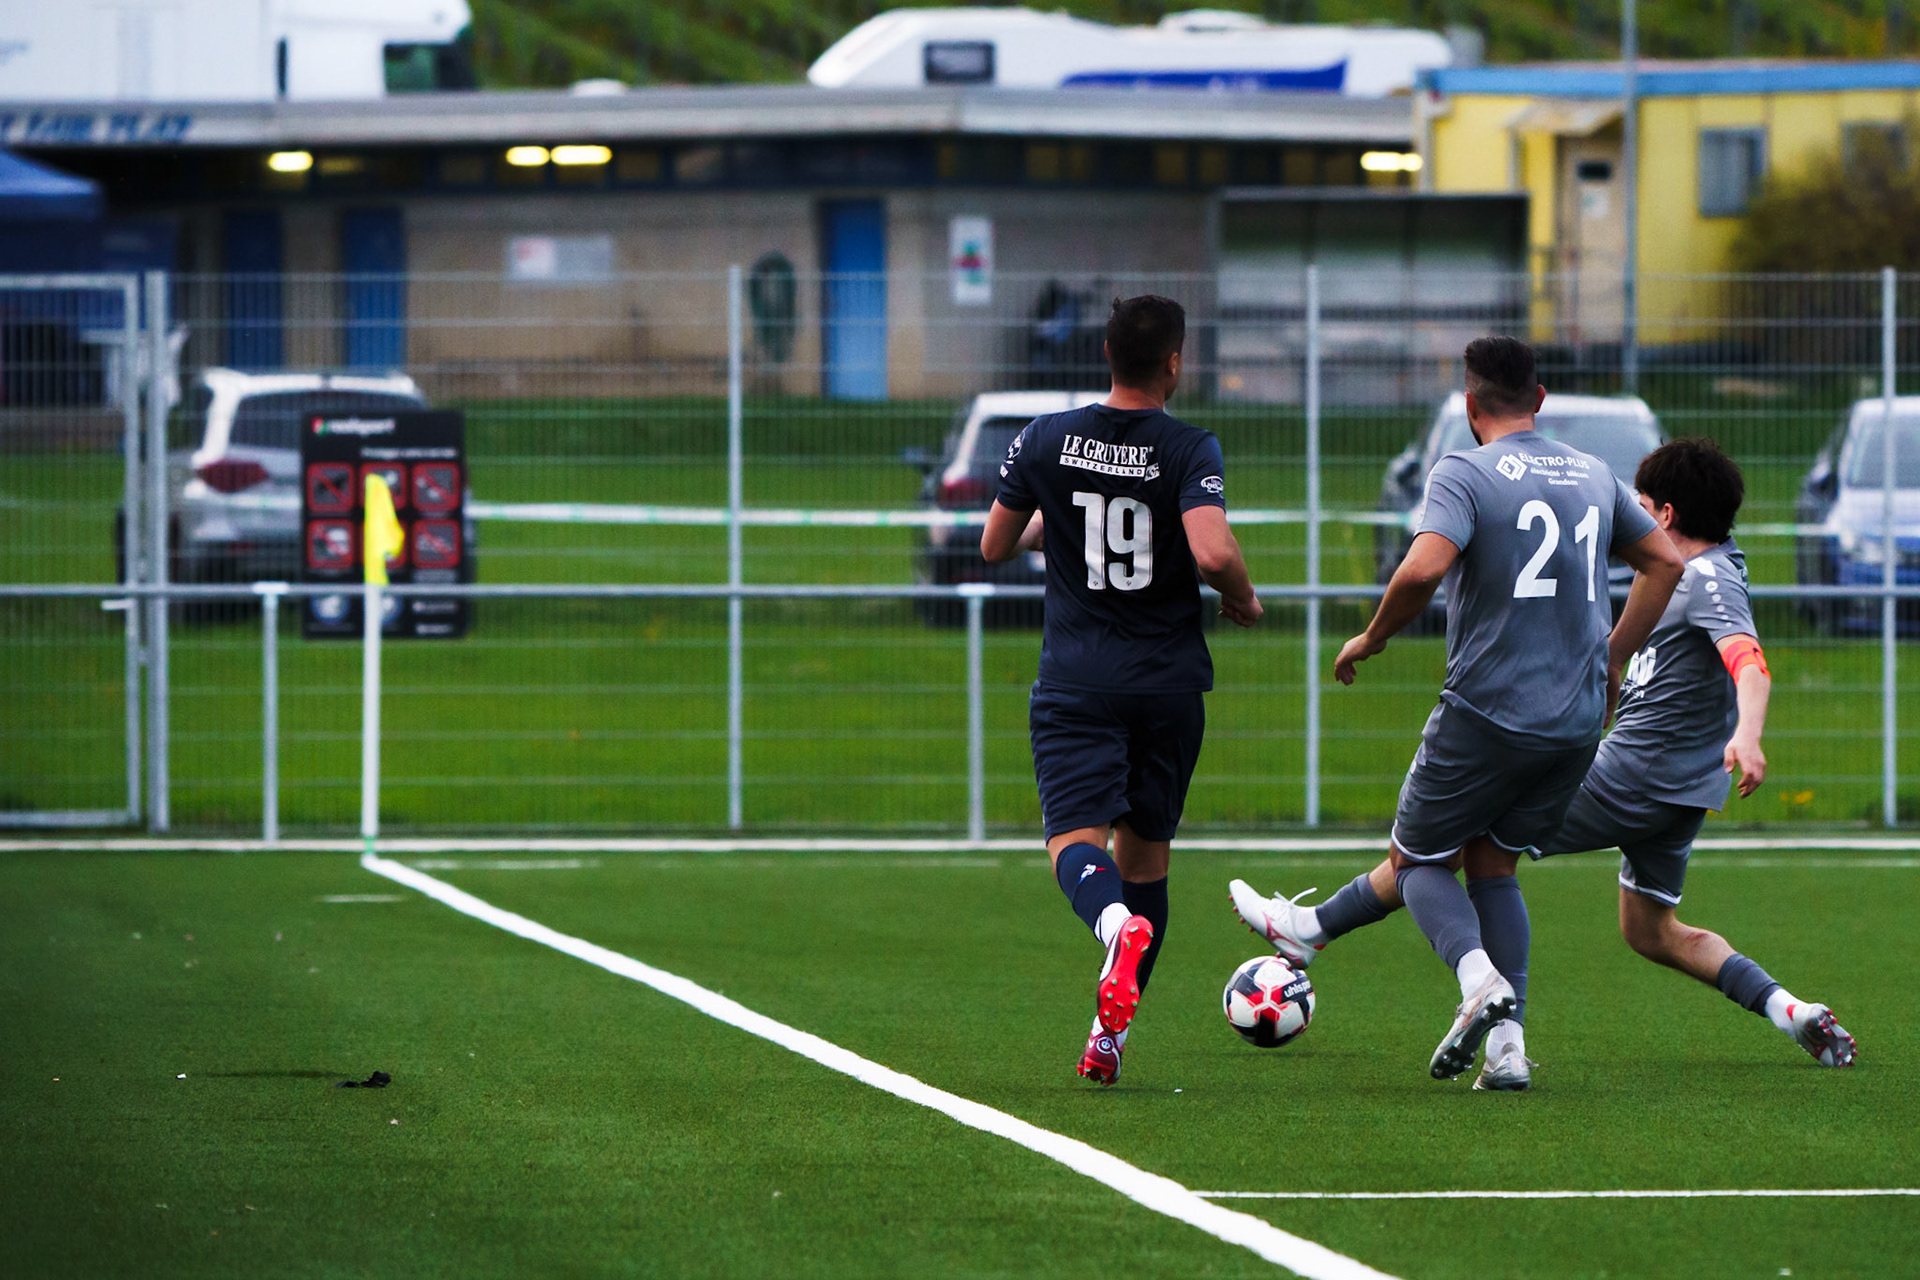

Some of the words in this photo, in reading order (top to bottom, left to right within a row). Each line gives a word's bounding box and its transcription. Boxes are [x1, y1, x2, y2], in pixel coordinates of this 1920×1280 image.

[1061, 434, 1082, 456] LE
[1064, 457, 1143, 476] SWITZERLAND
[1518, 452, 1590, 470] ELECTRO-PLUS
[1548, 478, 1579, 486] Grandson
[1072, 491, 1153, 591] 19
[1513, 499, 1599, 602] 21
[1284, 980, 1311, 998] uhlspo
